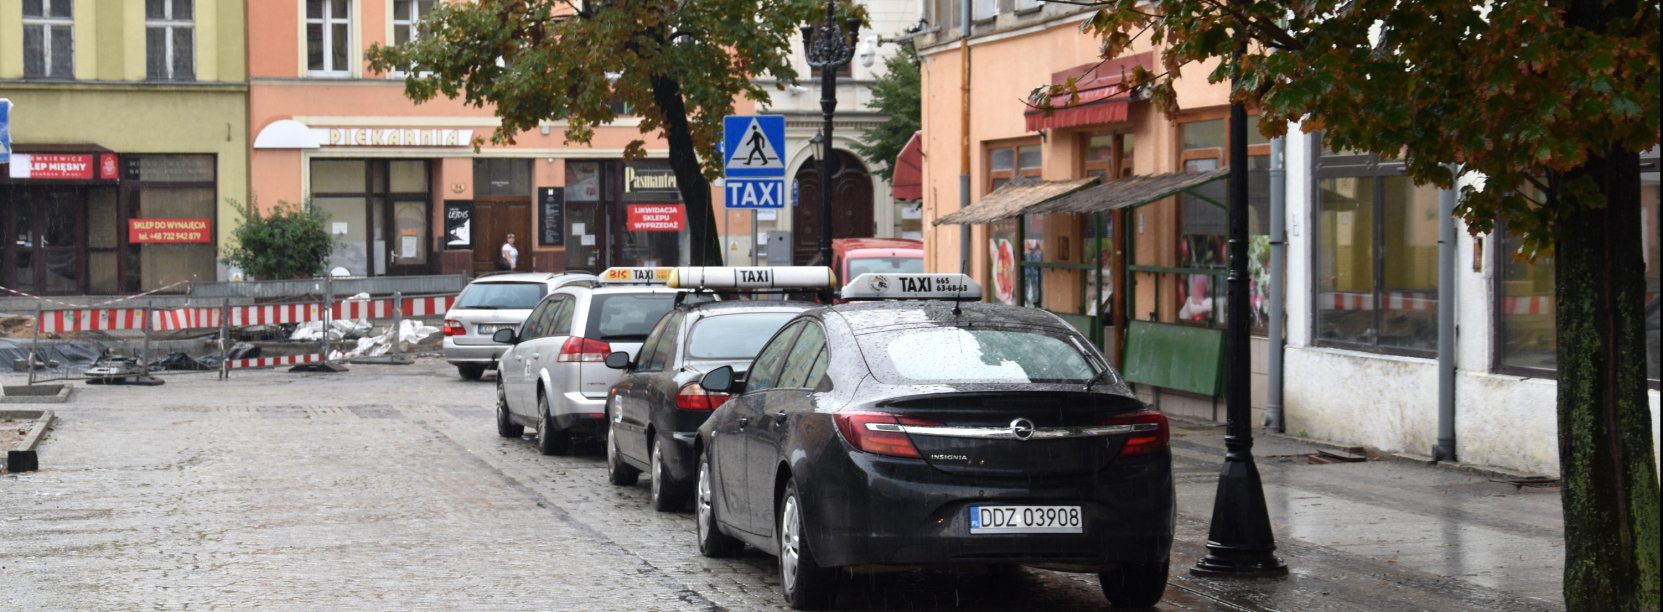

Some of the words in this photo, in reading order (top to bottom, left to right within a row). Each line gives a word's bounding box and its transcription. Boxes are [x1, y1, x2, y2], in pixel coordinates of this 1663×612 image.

[329, 128, 460, 145] PIEKARNIA
[48, 162, 87, 173] MIĘSNY
[727, 182, 783, 206] TAXI
[133, 221, 154, 229] SKLEP
[154, 221, 166, 229] DO
[166, 221, 206, 230] WYNAJĘCIA
[634, 221, 679, 229] WYPRZEDAŻ
[633, 269, 653, 280] TAXI
[740, 270, 769, 282] TAXI
[899, 277, 932, 292] TAXI
[980, 508, 1017, 528] DDZ
[1023, 508, 1079, 527] 03908
